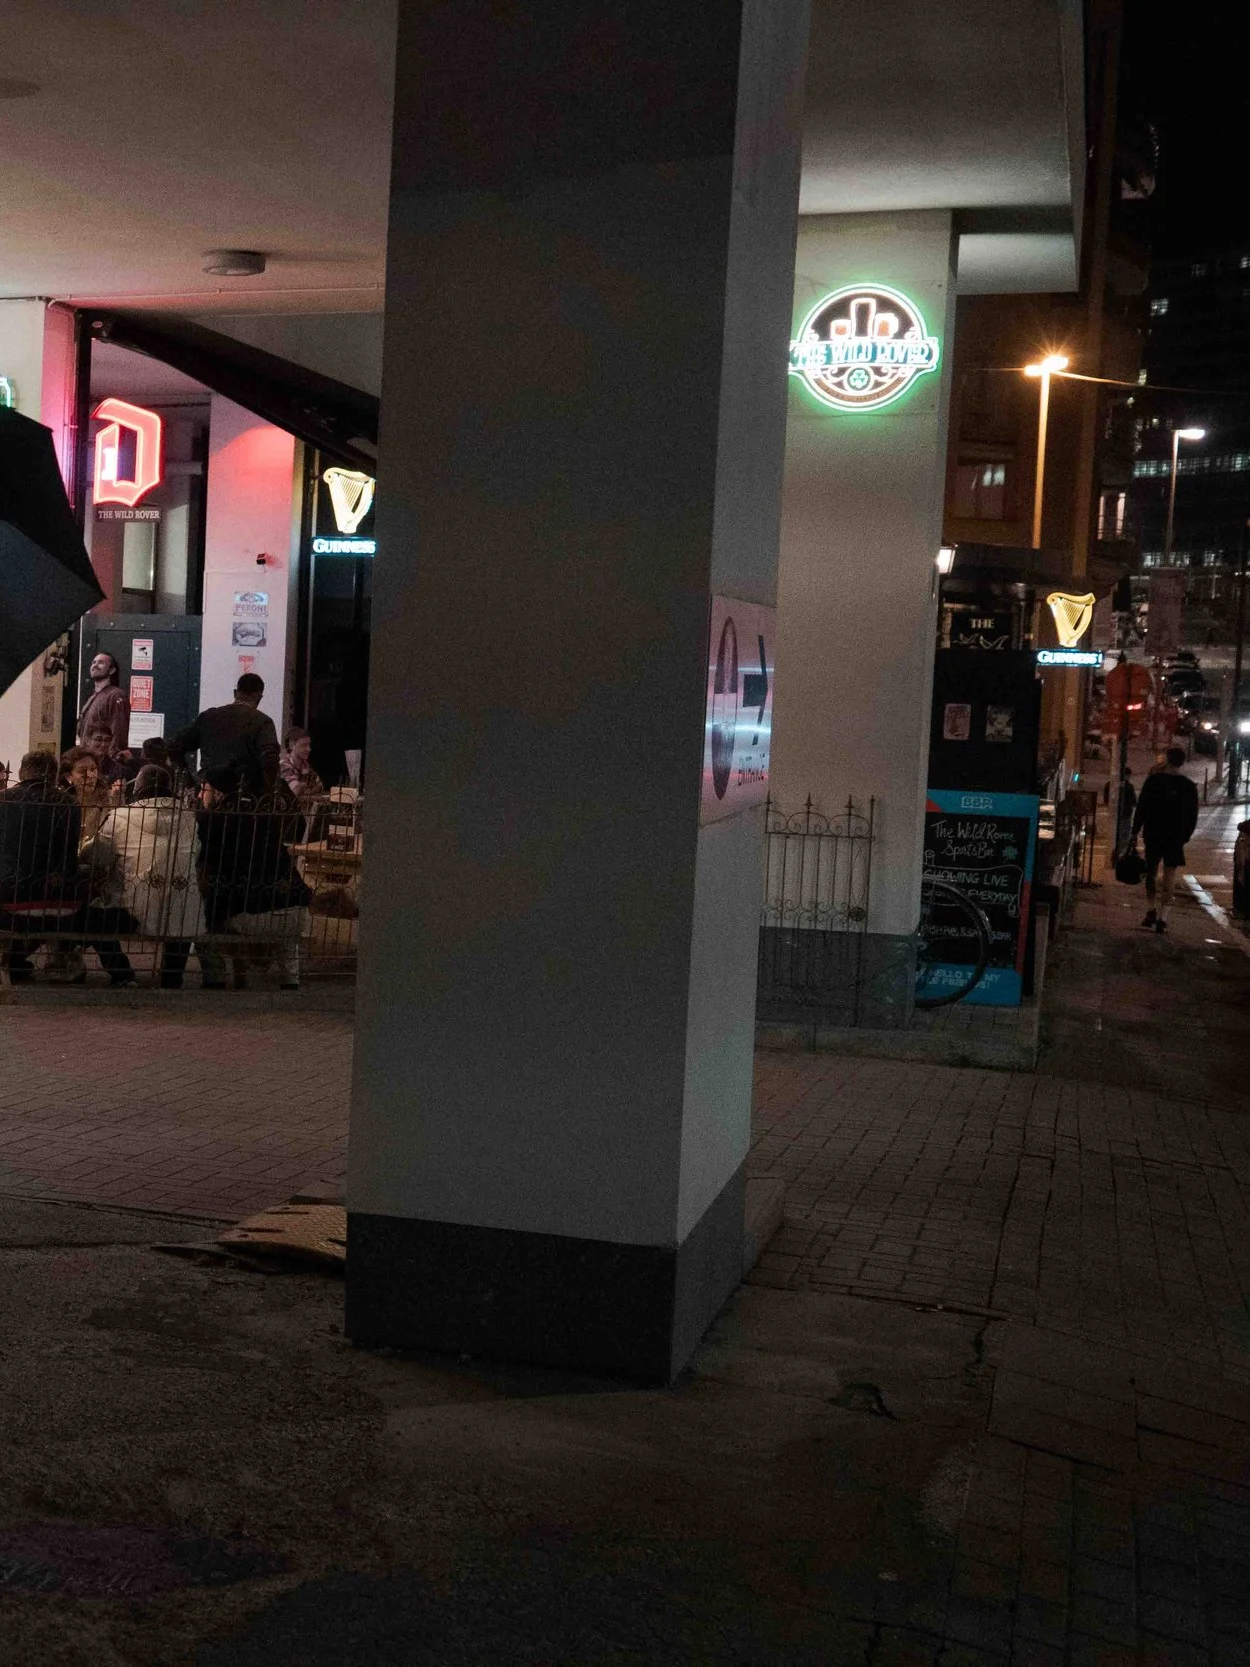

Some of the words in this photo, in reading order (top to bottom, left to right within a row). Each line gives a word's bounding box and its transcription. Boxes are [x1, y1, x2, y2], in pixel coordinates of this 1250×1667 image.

[98, 510, 113, 519] THE
[114, 510, 134, 519] WILD
[135, 510, 160, 519] ROVER
[969, 618, 995, 629] THE
[132, 688, 151, 699] ZONE
[930, 820, 954, 839] The
[957, 821, 987, 840] Wild
[983, 873, 1011, 887] LIVE
